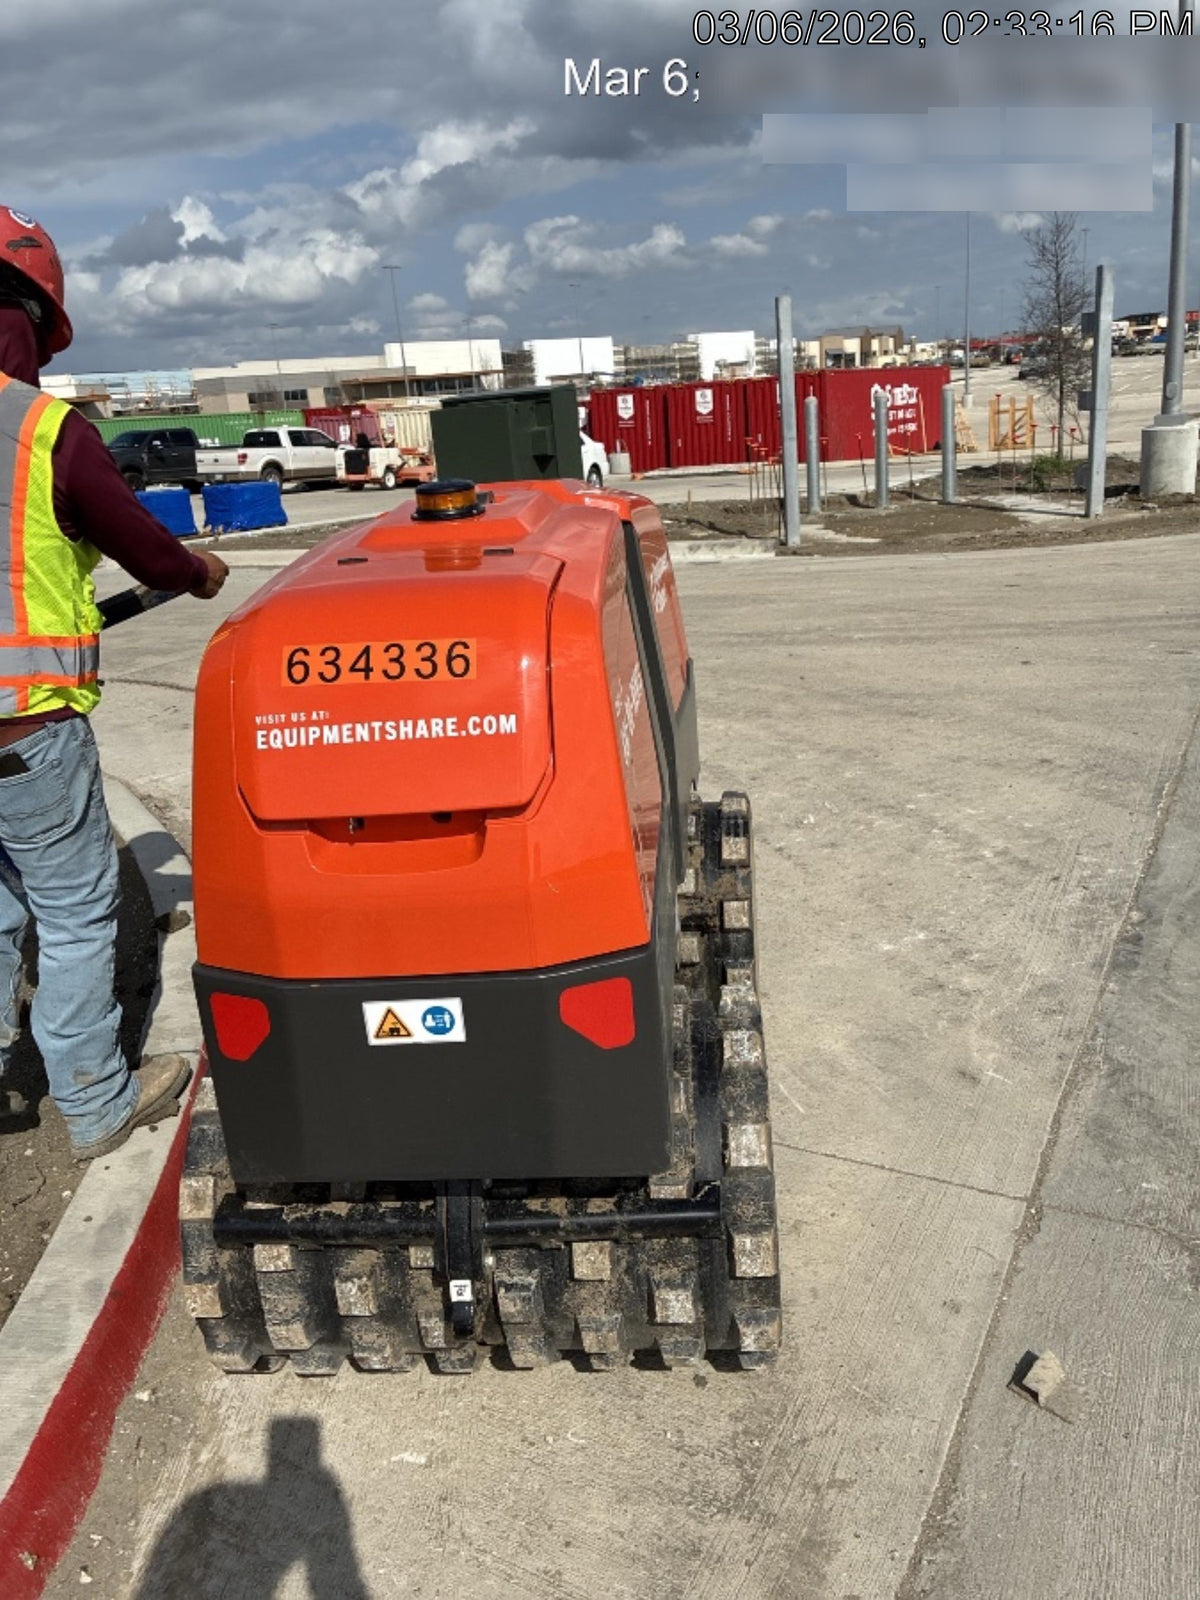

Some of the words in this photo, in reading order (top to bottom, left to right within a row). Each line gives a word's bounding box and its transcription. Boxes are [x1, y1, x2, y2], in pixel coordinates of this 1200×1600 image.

[286, 640, 471, 685] 634336
[255, 713, 286, 725] VISIT
[291, 711, 307, 723] US
[256, 713, 517, 750] EQUIPMENTSHARE.COM
